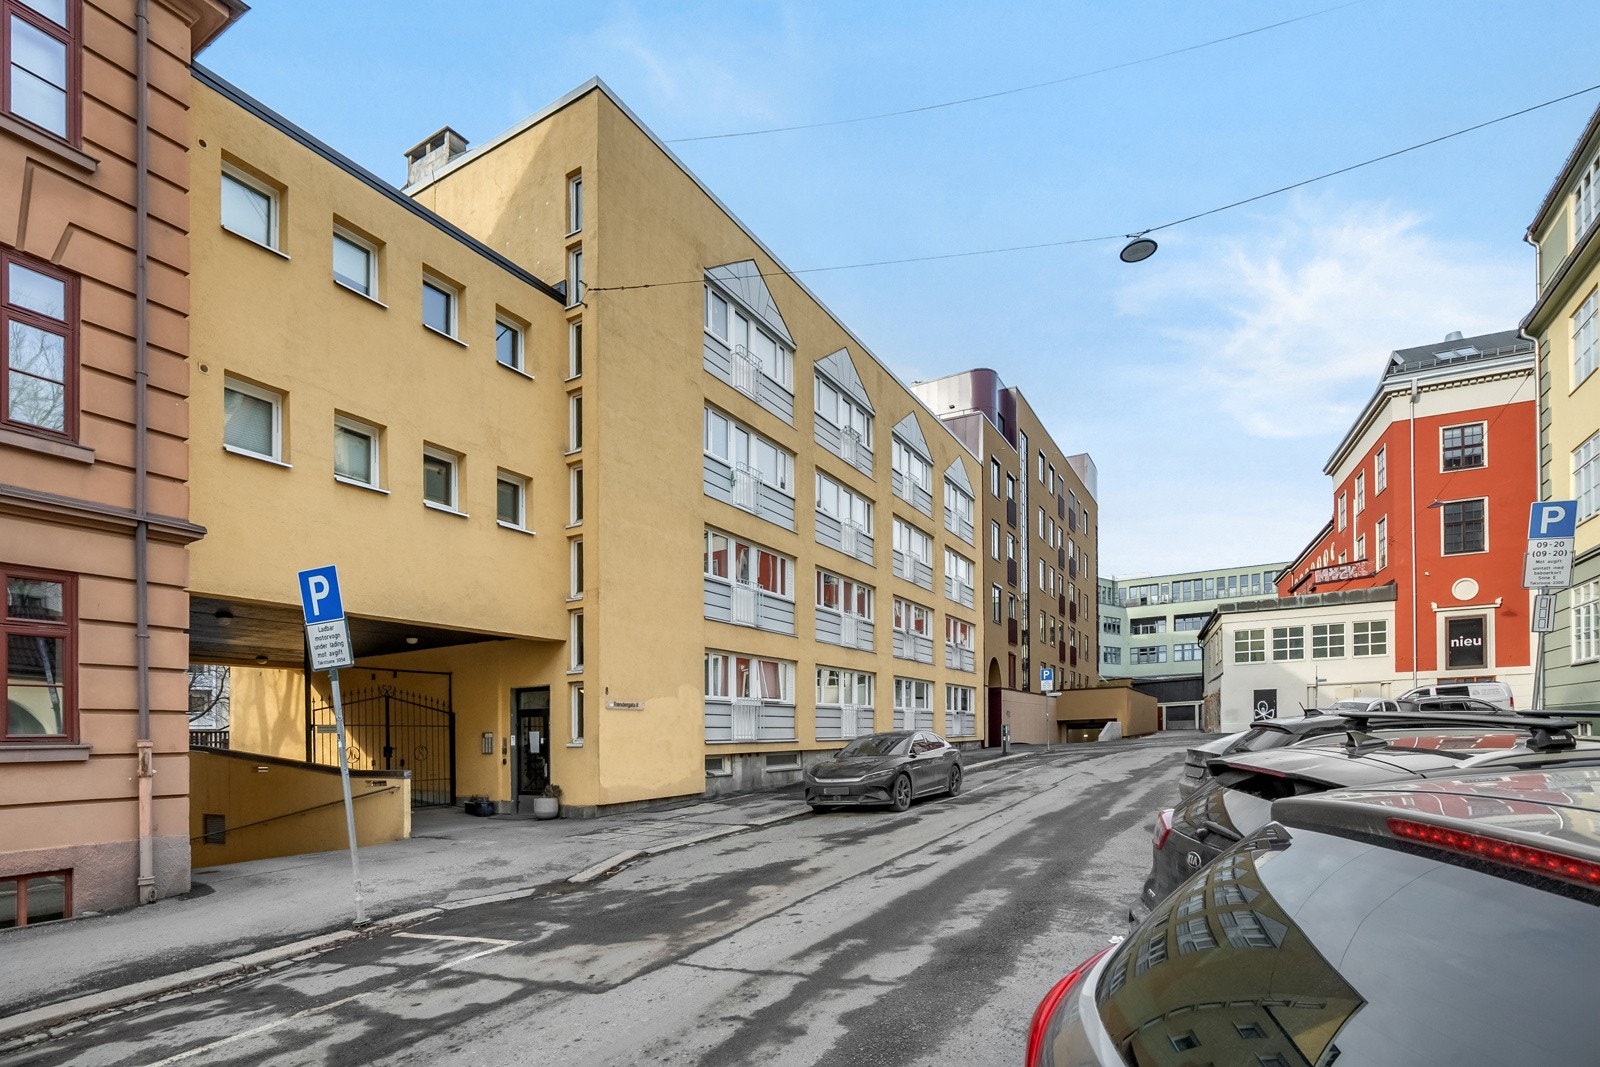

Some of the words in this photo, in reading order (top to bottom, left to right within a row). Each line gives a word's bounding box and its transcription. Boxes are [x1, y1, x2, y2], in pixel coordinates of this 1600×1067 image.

[1540, 505, 1566, 534] P
[308, 575, 330, 616] P
[315, 633, 341, 641] motorvogn
[1451, 636, 1482, 647] nieu
[329, 649, 343, 657] avgift
[1043, 670, 1050, 680] P
